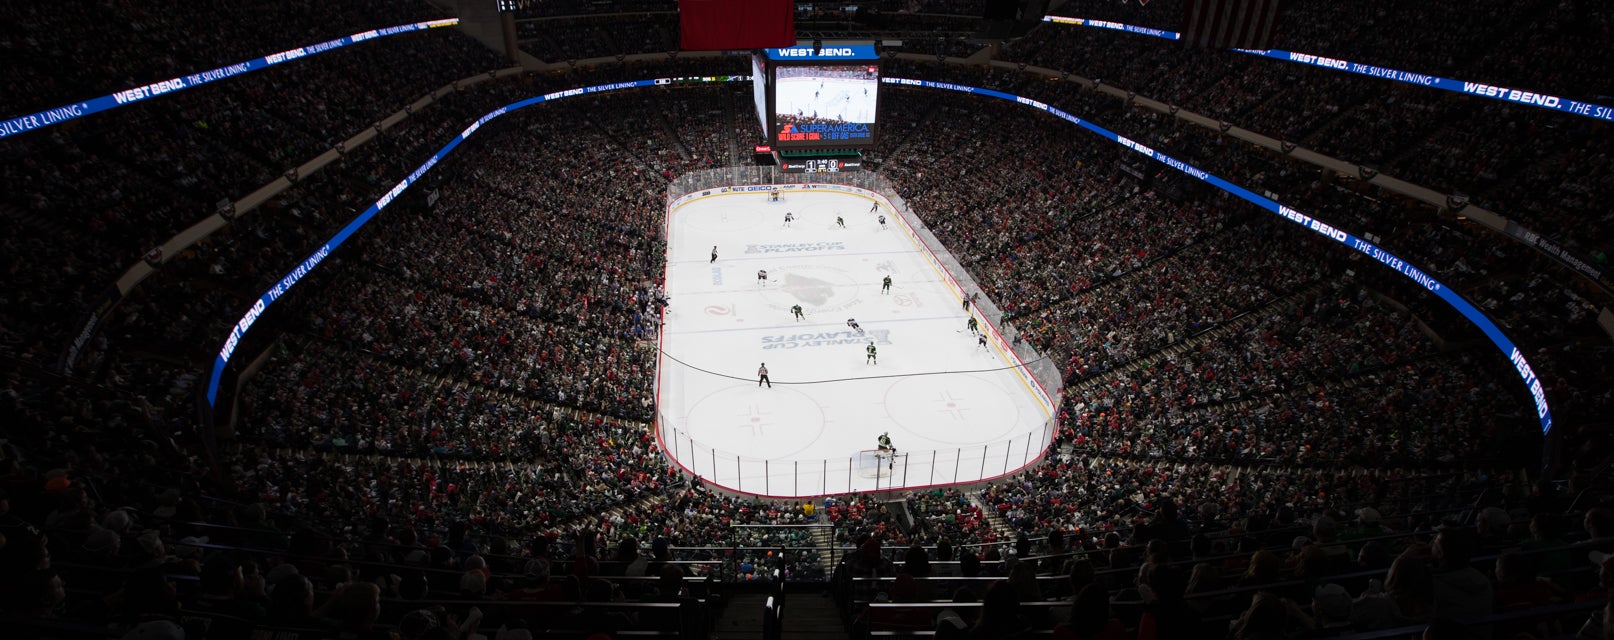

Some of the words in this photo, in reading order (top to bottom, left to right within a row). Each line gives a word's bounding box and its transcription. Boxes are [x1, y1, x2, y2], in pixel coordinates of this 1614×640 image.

[265, 52, 286, 64] WEST
[306, 45, 316, 54] THE
[315, 41, 329, 52] SILVER
[779, 48, 815, 57] WEST
[112, 85, 151, 104] WEST
[187, 75, 201, 86] THE
[202, 68, 225, 82] SILVER
[544, 91, 564, 101] WEST
[563, 88, 584, 97] BEND
[597, 84, 615, 92] SILVER
[900, 78, 922, 86] BEND
[936, 82, 953, 90] SILVER
[1290, 51, 1317, 64] WEST
[1353, 63, 1368, 74] THE
[1369, 66, 1397, 79] SILVER
[1463, 81, 1509, 98] WEST
[1569, 101, 1592, 115] THE
[0, 116, 41, 136] SILVER
[800, 123, 869, 132] SUPERAMERICA
[1117, 135, 1135, 149] WEST
[1134, 142, 1154, 157] BEND
[1157, 152, 1167, 163] THE
[1166, 157, 1184, 172] SILVER
[1278, 205, 1312, 227] WEST
[1310, 220, 1347, 243] BEND
[1354, 239, 1372, 255] THE
[1372, 248, 1403, 272] SILVER
[1524, 231, 1541, 245] RBC
[1538, 237, 1561, 256] Wealth
[1559, 249, 1602, 281] Management
[219, 325, 241, 363] WEST
[238, 299, 265, 333] BEND
[268, 284, 284, 301] THE
[283, 265, 307, 290] SILVER
[761, 330, 866, 344] PLAYOFFS
[762, 341, 800, 350] CUP
[801, 336, 873, 347] STANLEY
[1510, 346, 1536, 385] WEST
[1530, 378, 1549, 419] BEND
